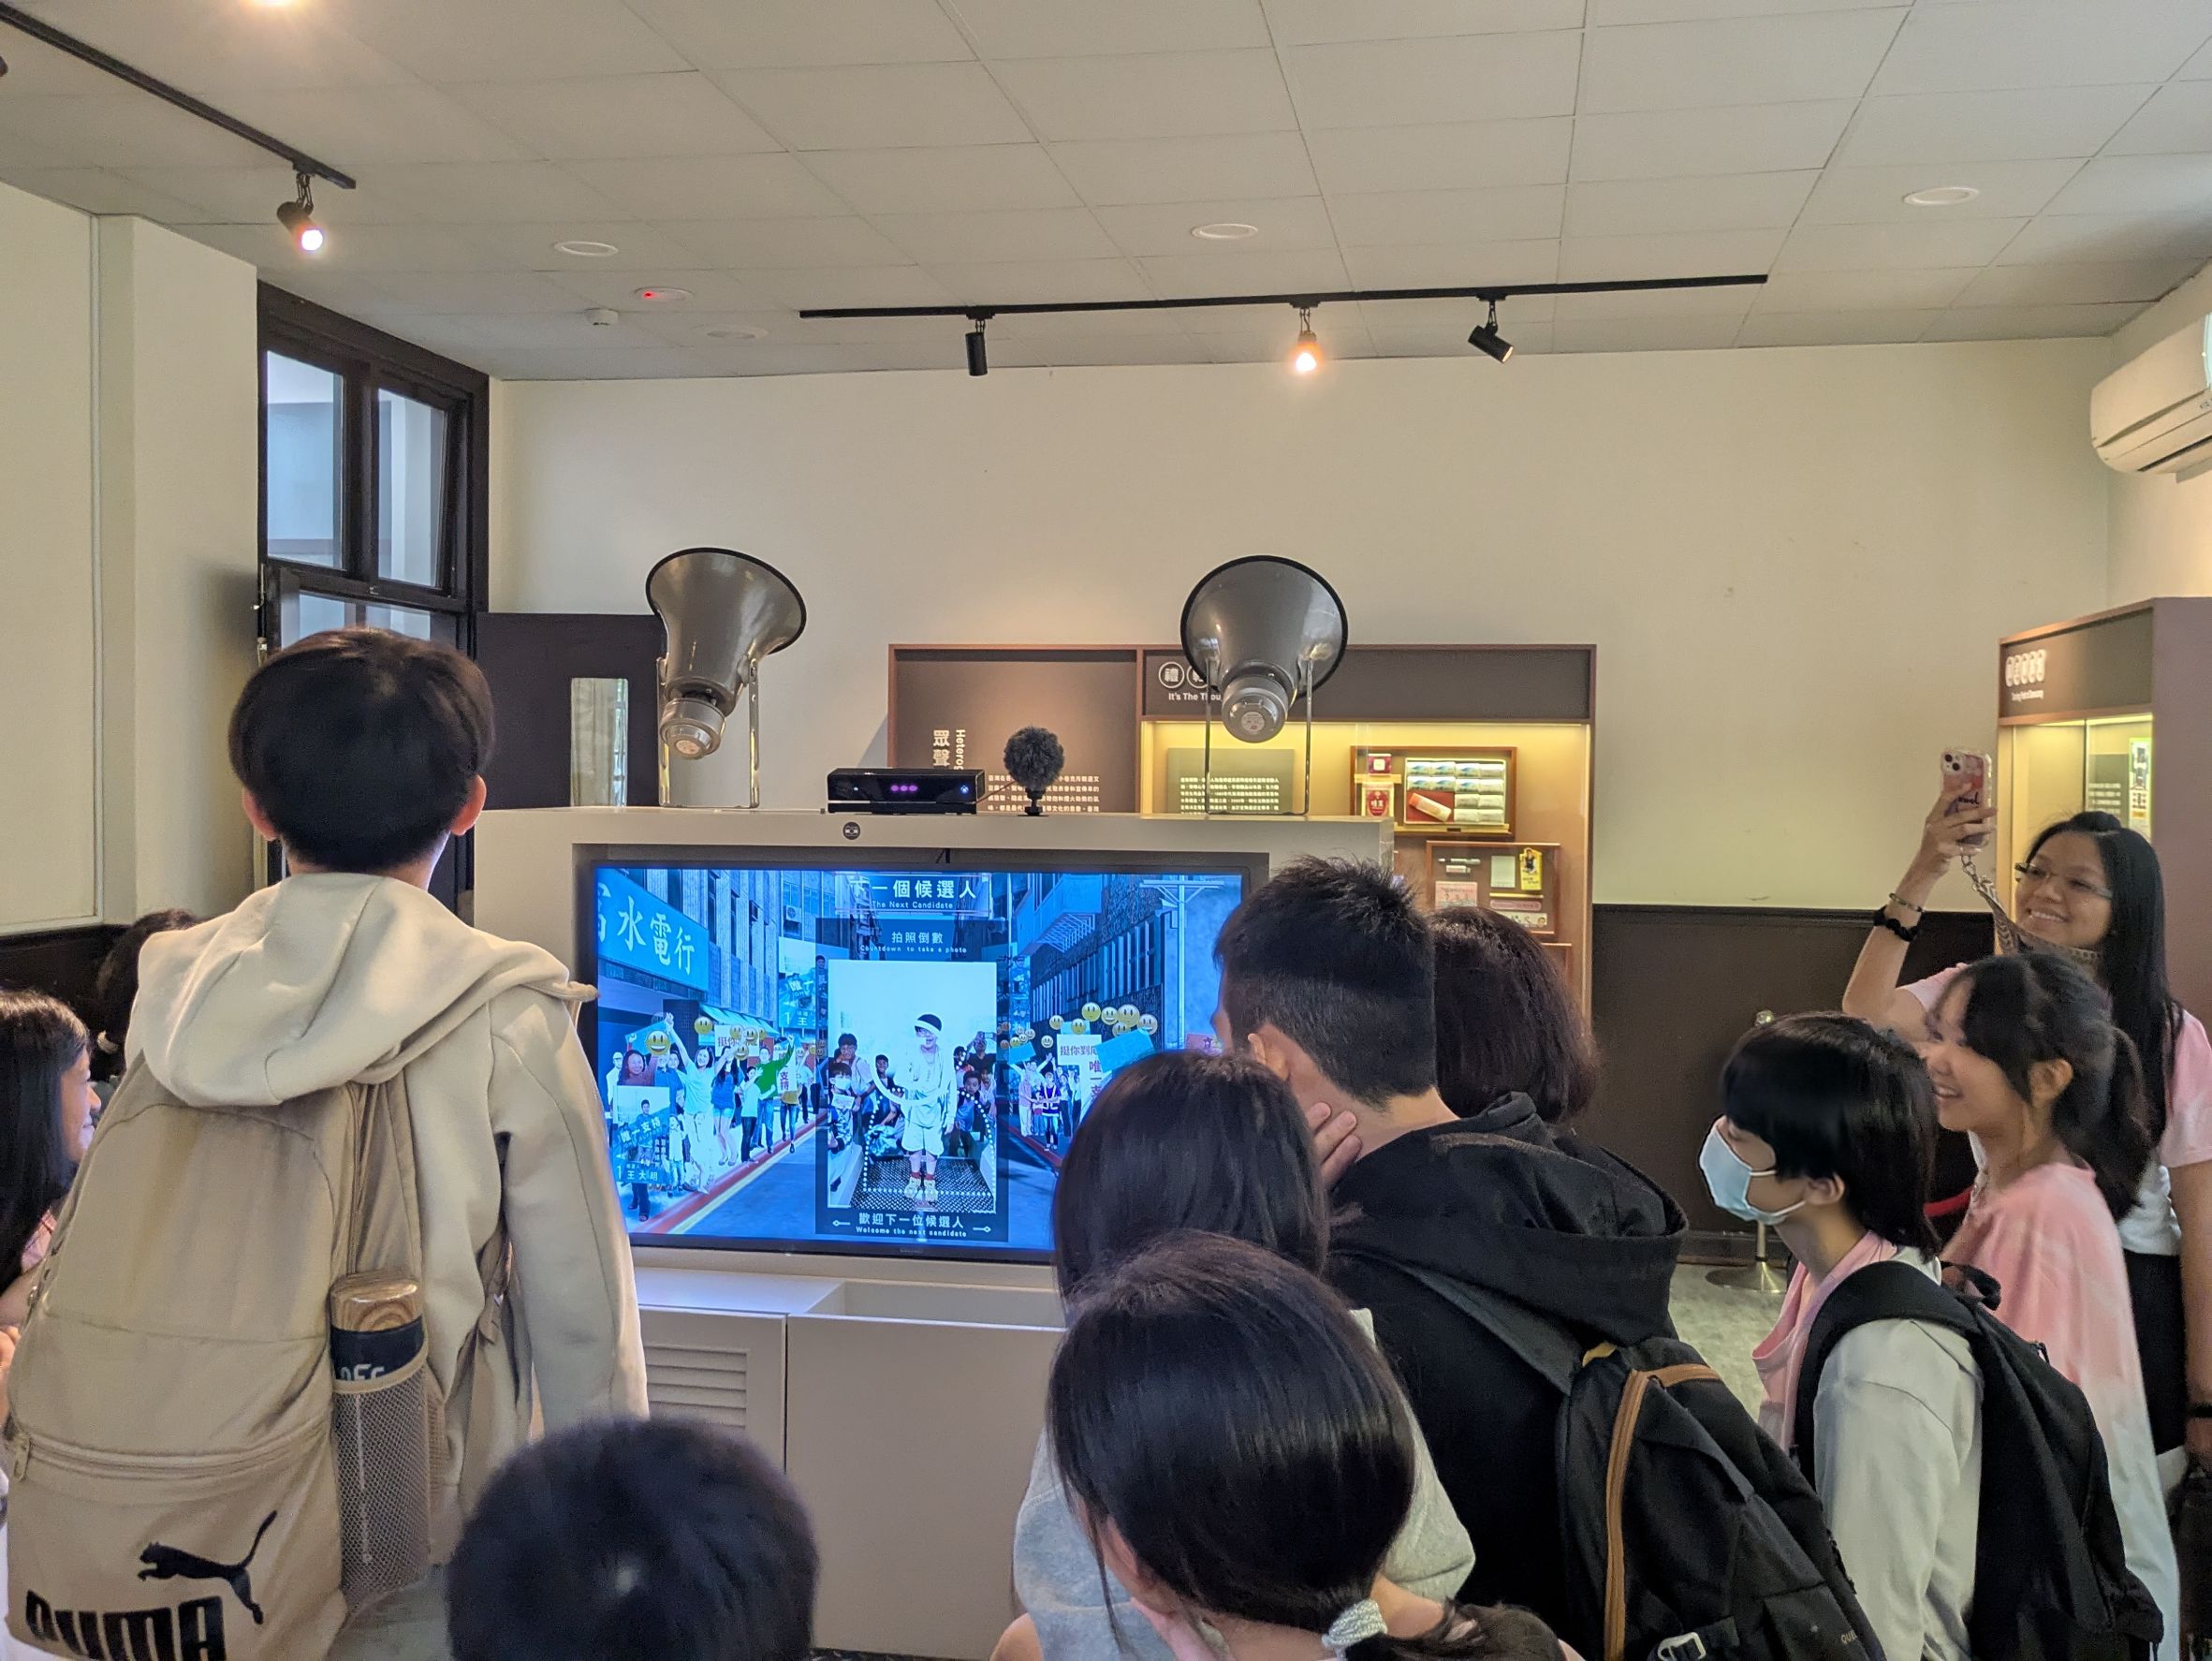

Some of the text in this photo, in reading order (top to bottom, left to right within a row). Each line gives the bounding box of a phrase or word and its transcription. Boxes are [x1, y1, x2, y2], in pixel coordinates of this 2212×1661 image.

[850, 879, 976, 900] 下一個候選人
[912, 901, 953, 909] Candidate
[891, 931, 944, 945] 拍照倒數
[858, 1212, 964, 1229] 歡迎下一位候選人
[856, 1226, 889, 1234] Welcome
[26, 1590, 227, 1661] PUMA
